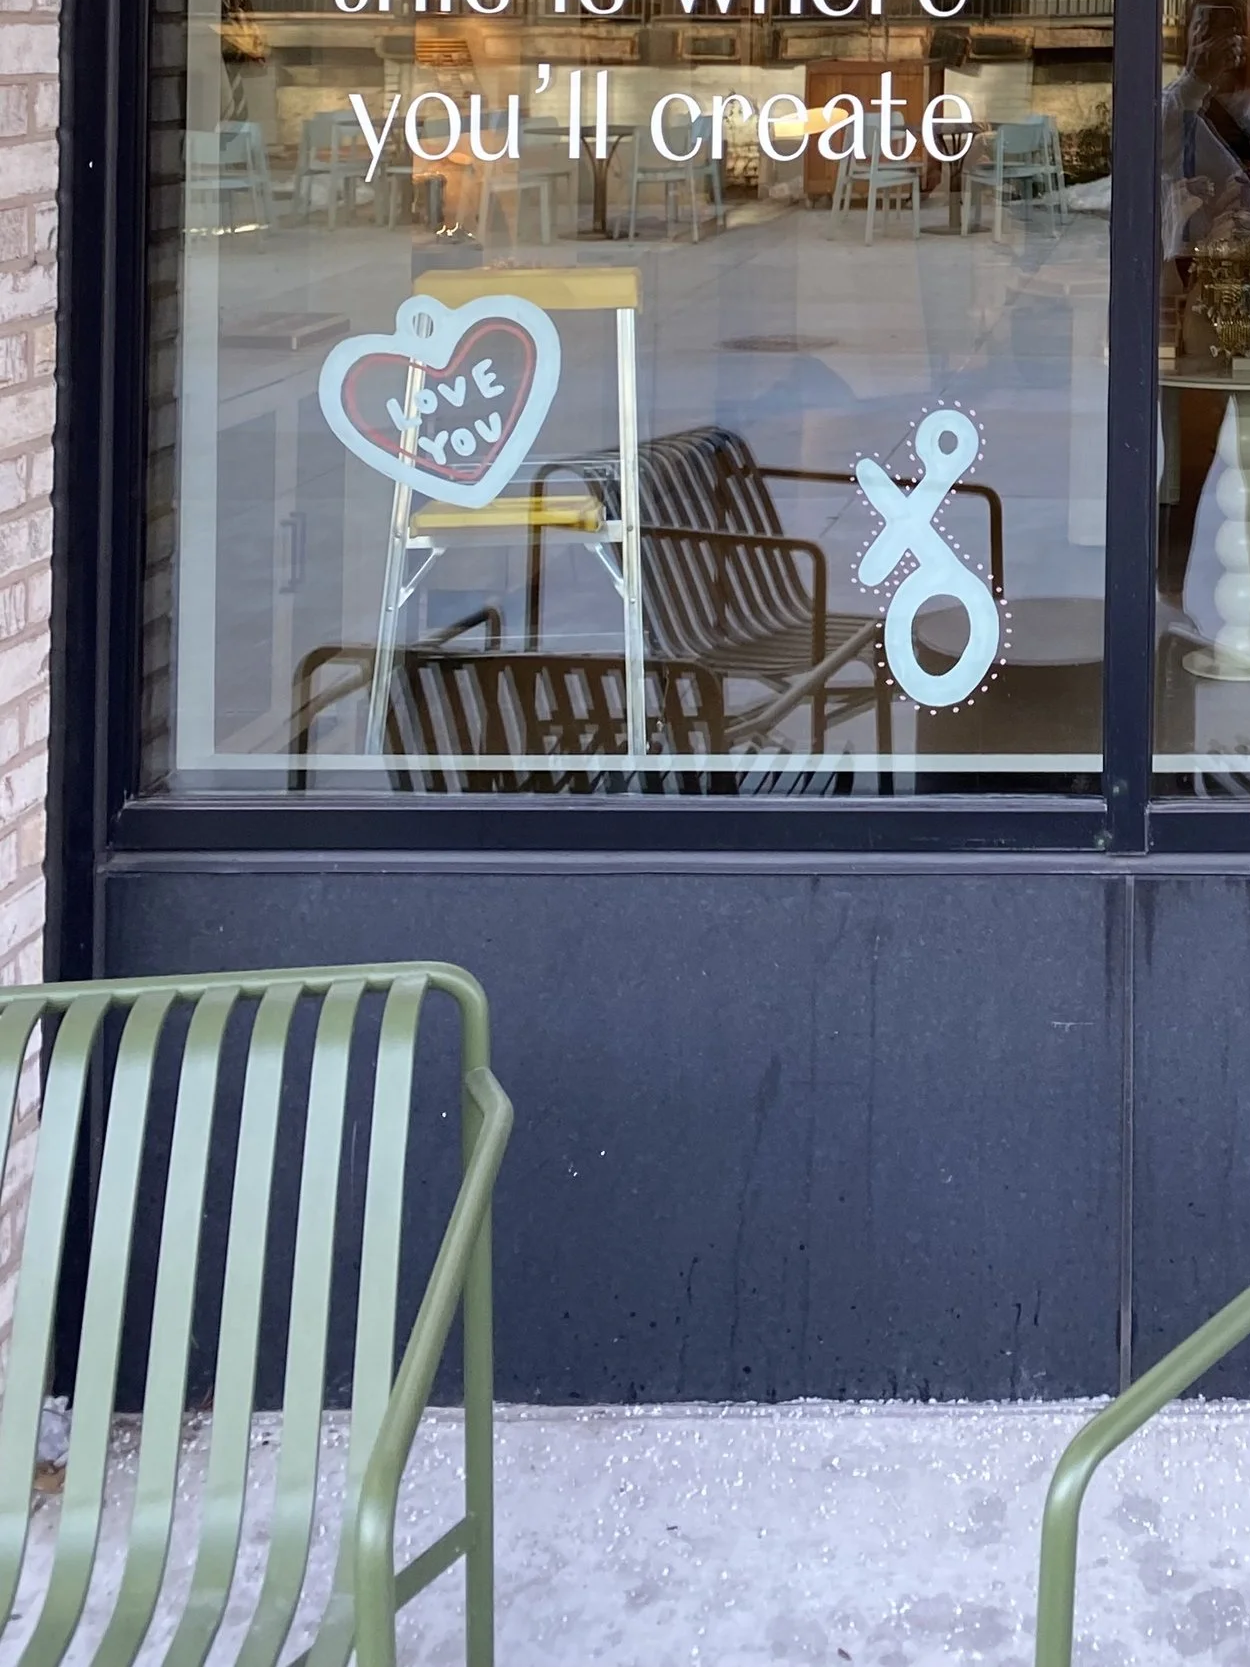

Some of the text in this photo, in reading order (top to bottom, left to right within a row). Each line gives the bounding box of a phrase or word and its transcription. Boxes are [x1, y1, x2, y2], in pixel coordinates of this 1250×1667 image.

[348, 64, 973, 182] you'll create
[386, 358, 505, 431] LOVE
[418, 412, 502, 465] YOU
